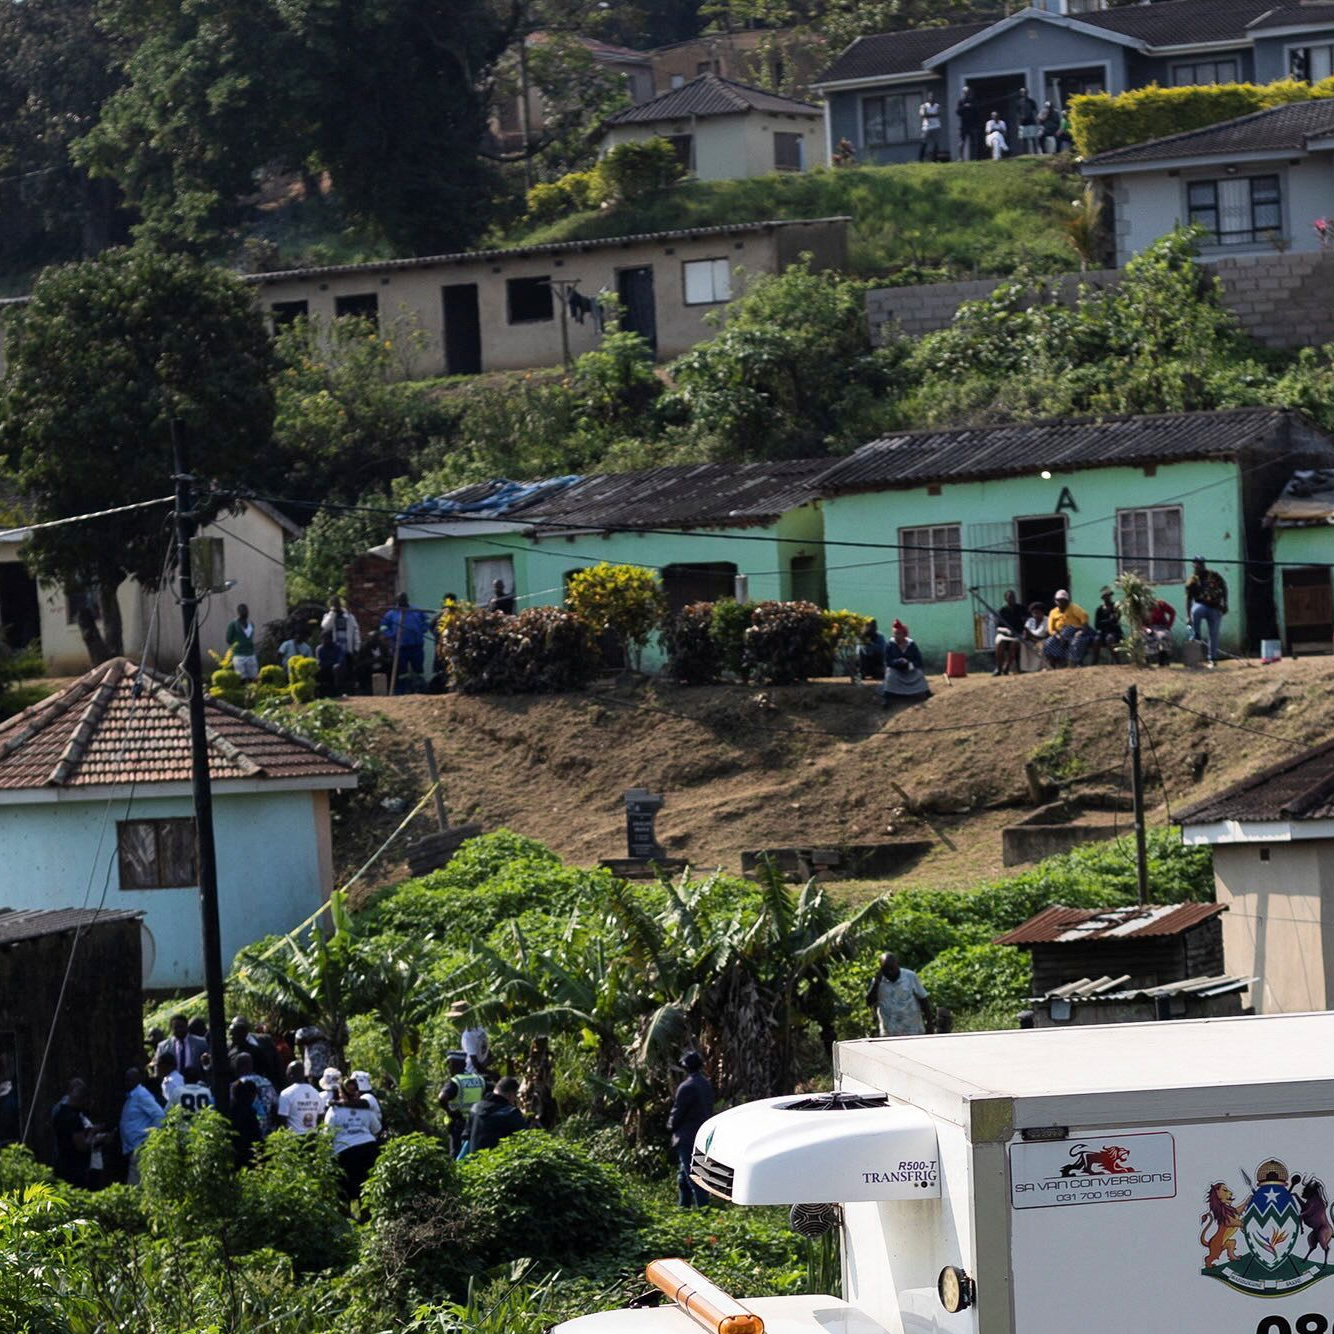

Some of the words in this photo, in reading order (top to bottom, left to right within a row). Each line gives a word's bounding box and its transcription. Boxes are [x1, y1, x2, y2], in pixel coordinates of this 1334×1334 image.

[898, 1161, 937, 1171] R500-T
[862, 1170, 937, 1184] TRANSFRIG
[1015, 1183, 1035, 1192] SA
[1081, 1191, 1102, 1200] 700
[1105, 1189, 1132, 1197] 1590
